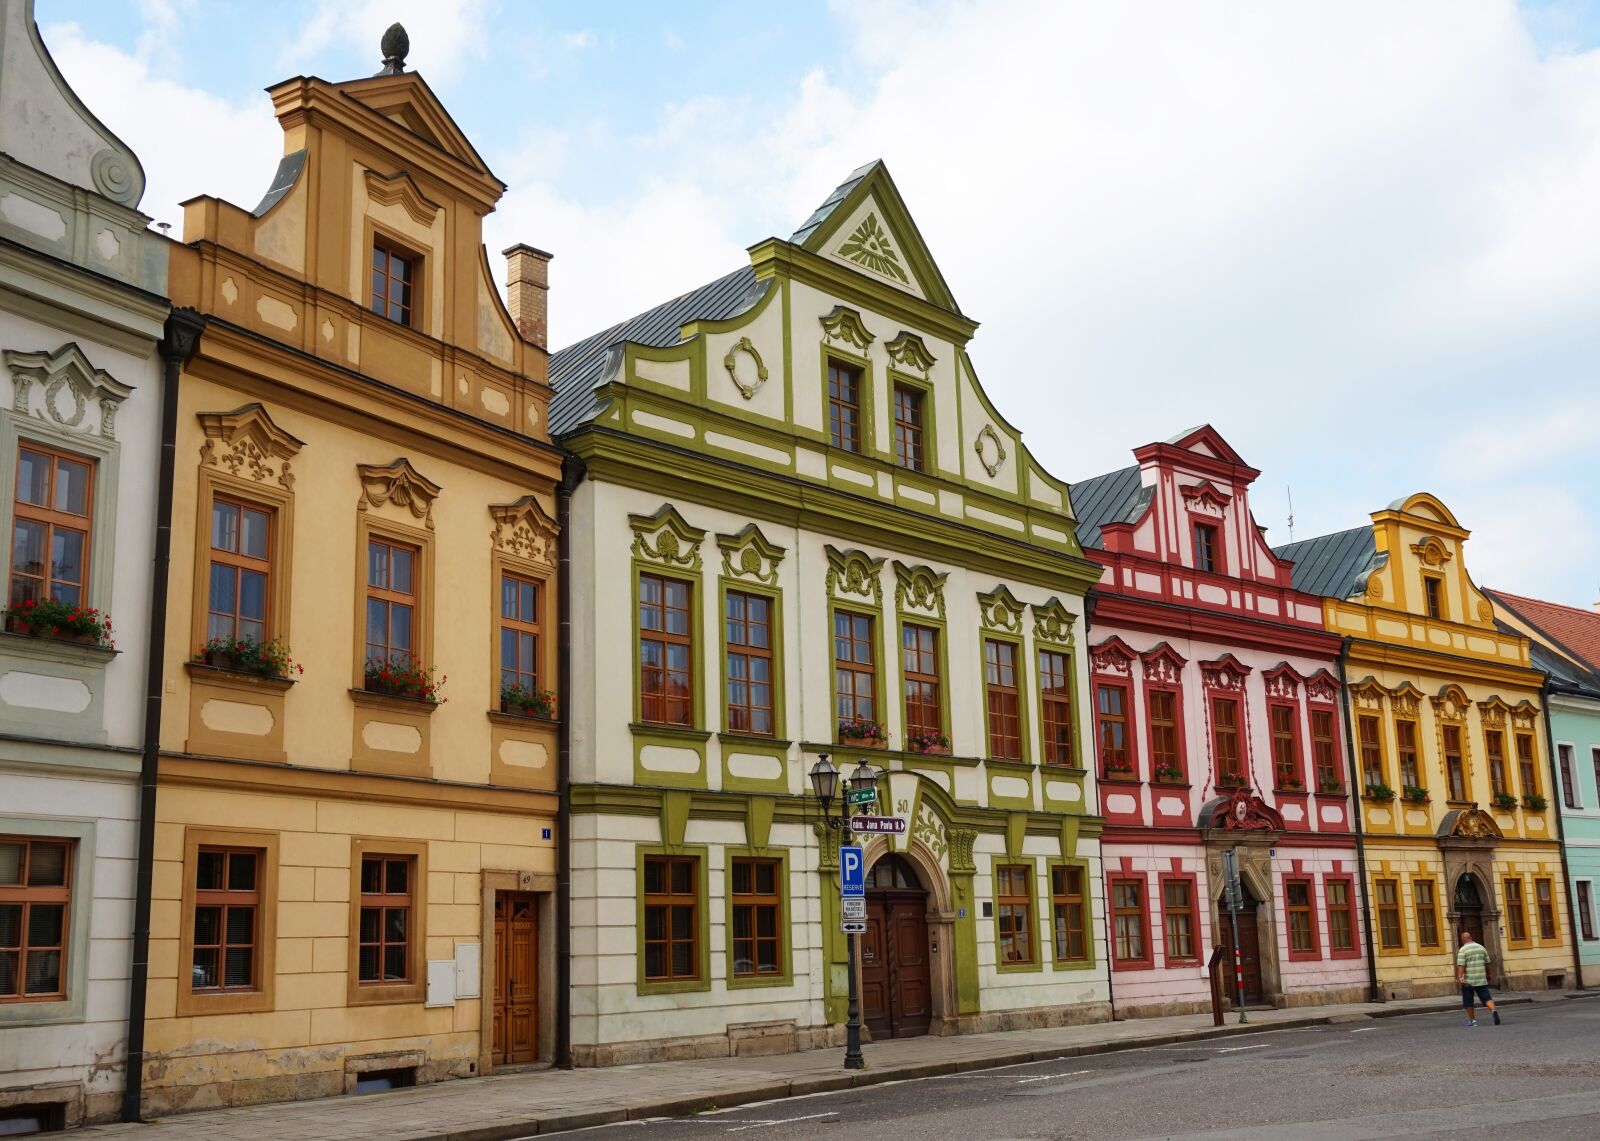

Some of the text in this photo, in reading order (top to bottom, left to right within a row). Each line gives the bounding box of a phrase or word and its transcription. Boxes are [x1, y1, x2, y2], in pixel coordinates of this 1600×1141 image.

[851, 793, 859, 802] WC
[866, 820, 878, 829] Jana
[880, 820, 893, 830] Pavla
[845, 853, 859, 881] P
